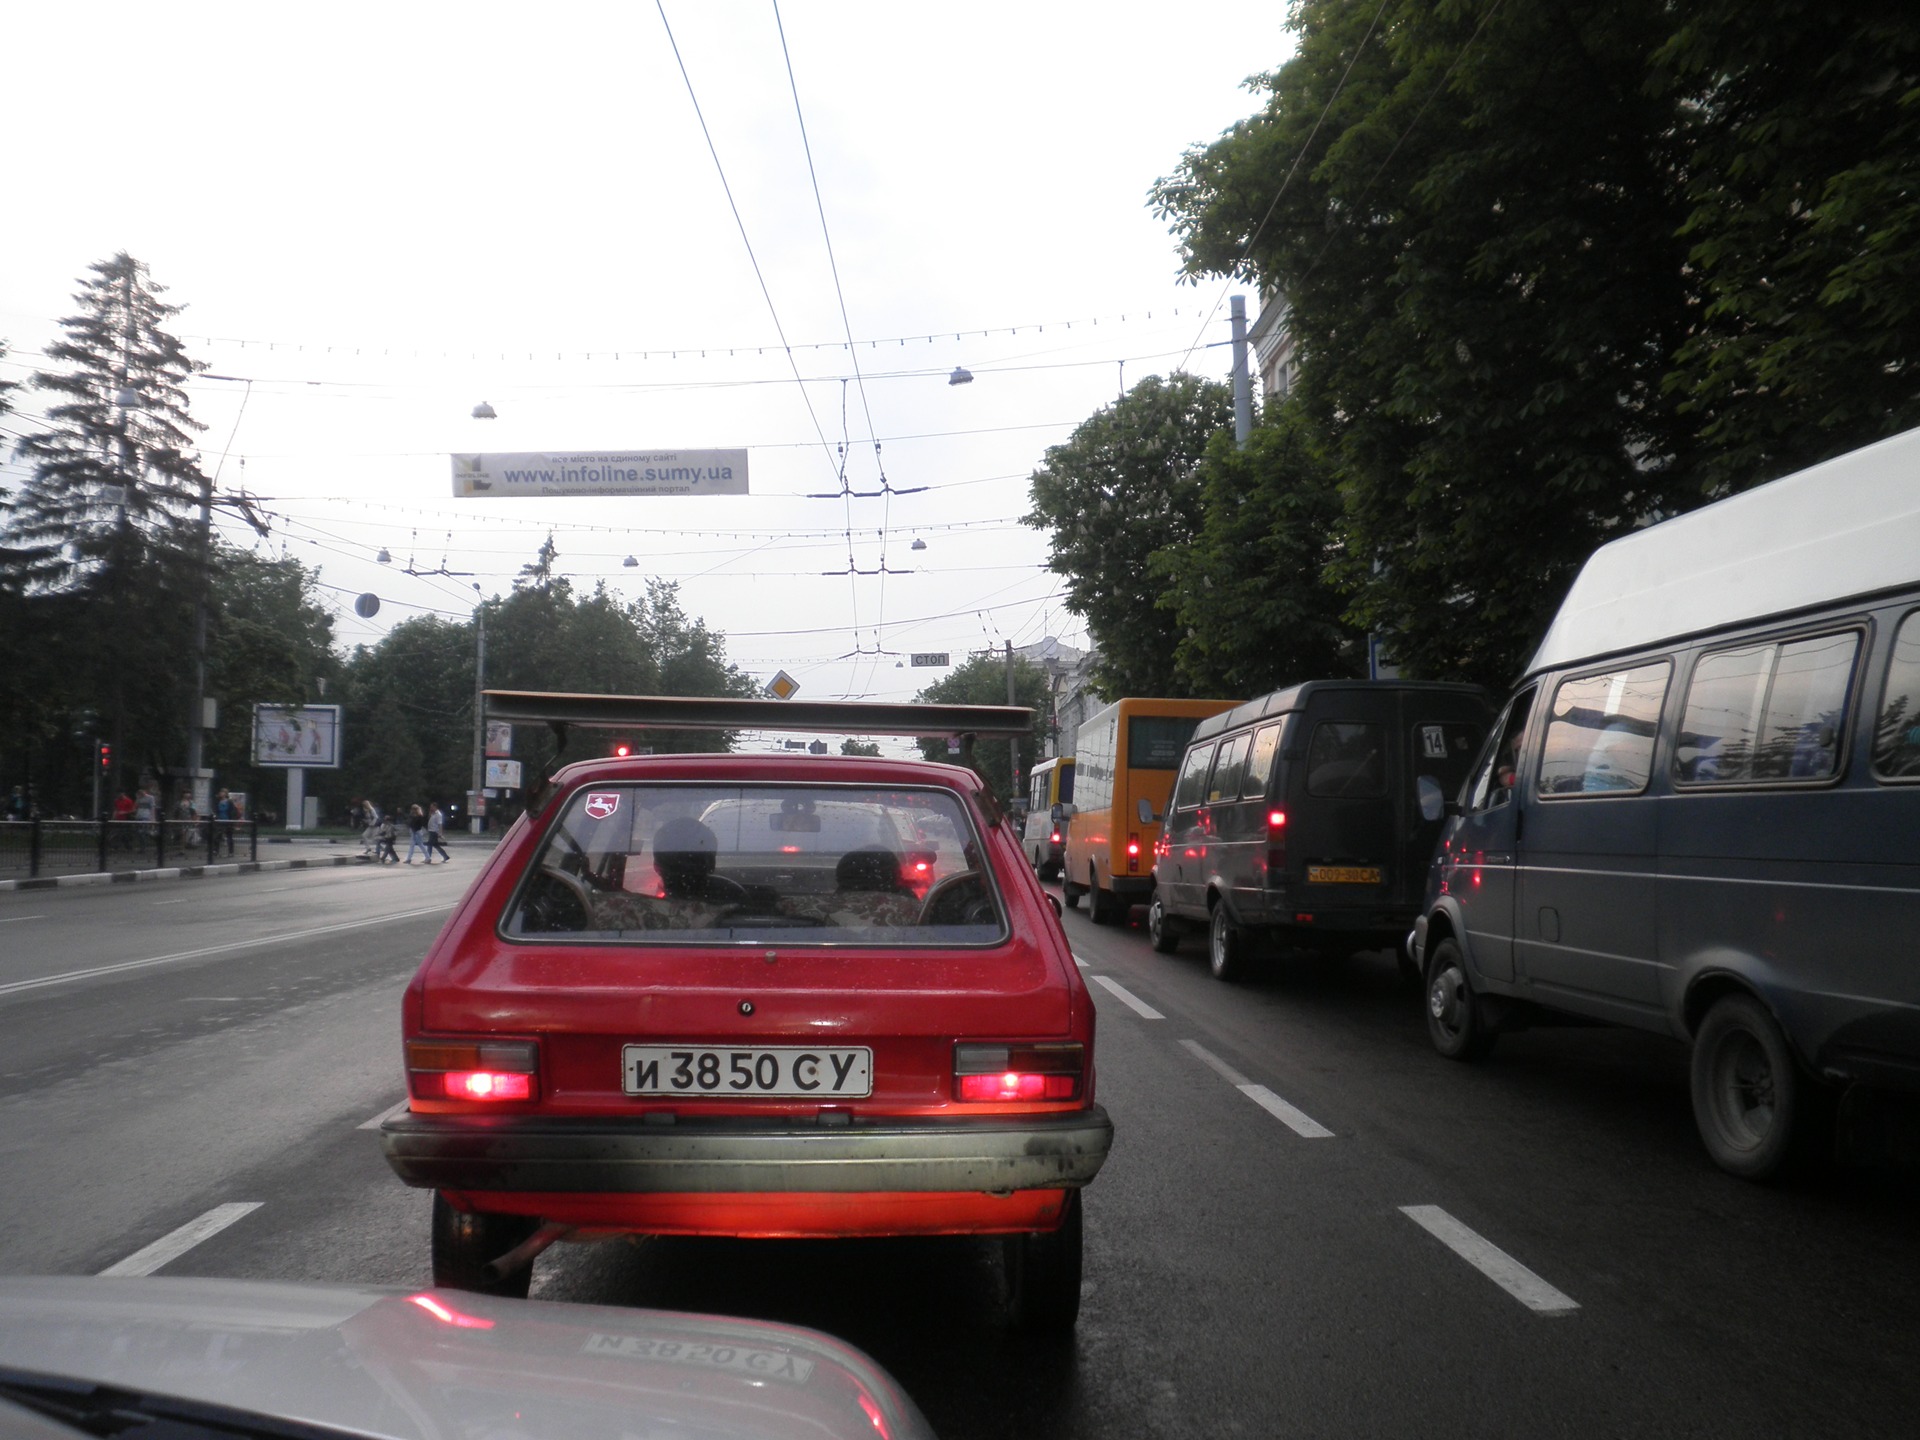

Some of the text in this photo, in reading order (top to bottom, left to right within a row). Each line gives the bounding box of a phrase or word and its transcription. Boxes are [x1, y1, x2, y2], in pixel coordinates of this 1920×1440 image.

[570, 454, 595, 463] місто
[597, 454, 609, 463] на
[653, 452, 678, 463] сайті
[504, 463, 733, 485] www.infoline.sumy.ua
[658, 484, 691, 496] портал
[915, 655, 946, 665] СТОП
[1426, 732, 1442, 753] 14
